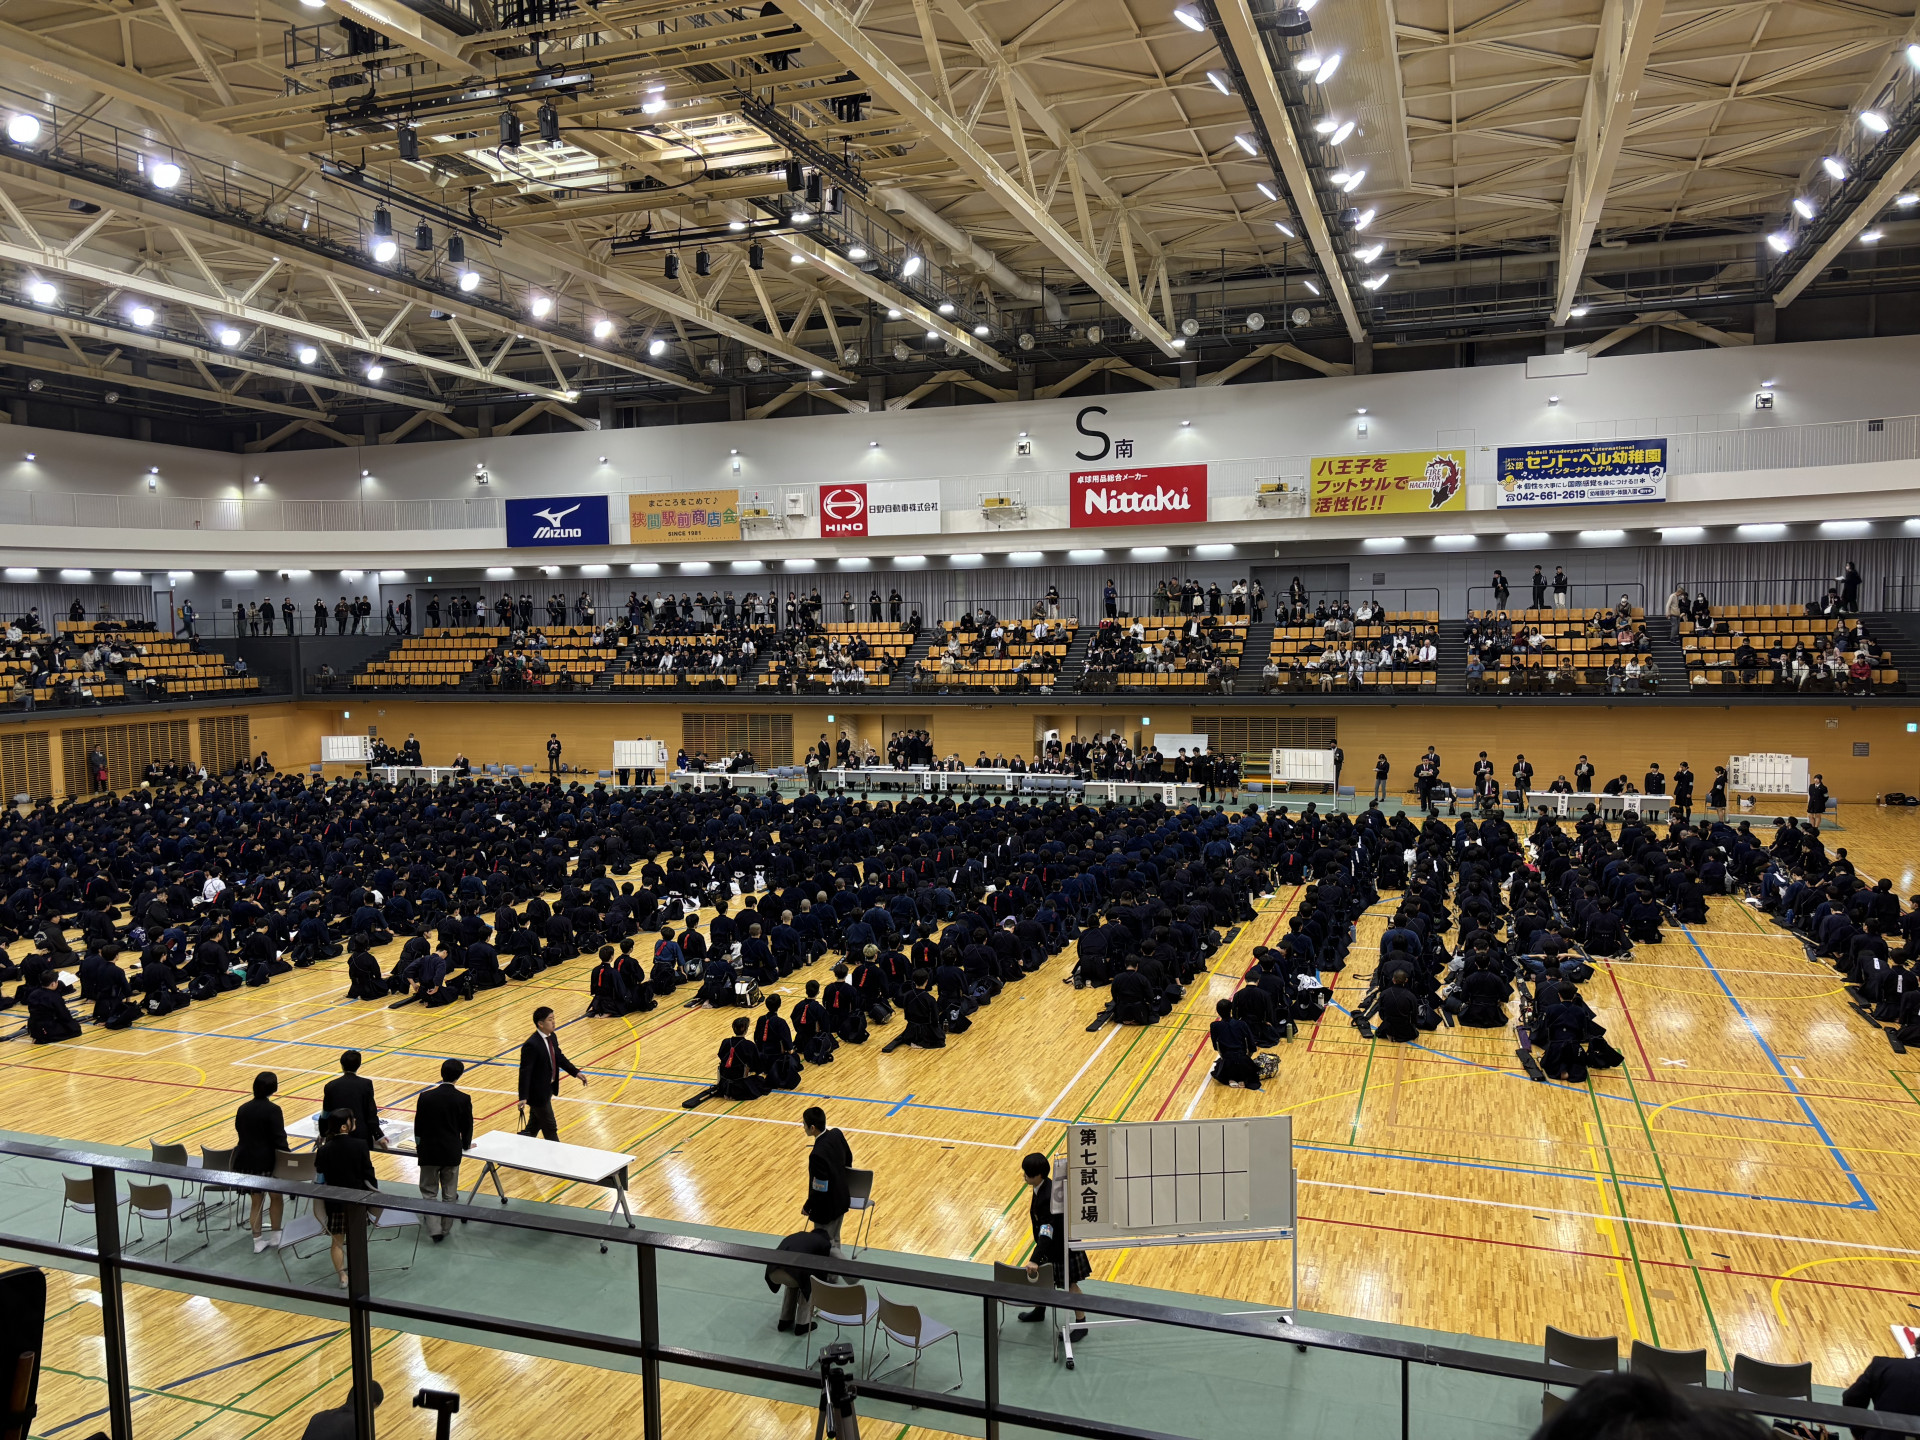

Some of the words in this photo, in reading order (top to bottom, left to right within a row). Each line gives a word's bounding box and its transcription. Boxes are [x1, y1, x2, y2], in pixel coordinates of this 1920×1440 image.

[1075, 406, 1111, 461] S
[1114, 439, 1134, 459] 南
[1316, 458, 1388, 477] 八王子を
[1525, 448, 1662, 470] セント・ベル幼稚園
[1076, 473, 1149, 484] 卓球用品総合メーカー
[1547, 465, 1613, 475] インターナショナル
[1316, 475, 1410, 494] フットサルで
[1408, 481, 1441, 489] HACHIOJI
[1085, 485, 1191, 515] Nittaku
[1516, 490, 1586, 501] 042-661-2619
[868, 502, 939, 514] 日野自動車株式会社
[632, 508, 738, 530] 狭間駅前商店会
[825, 522, 863, 532] HINO
[532, 526, 582, 539] MIZUNO
[1080, 1128, 1098, 1223] 第七試合場
